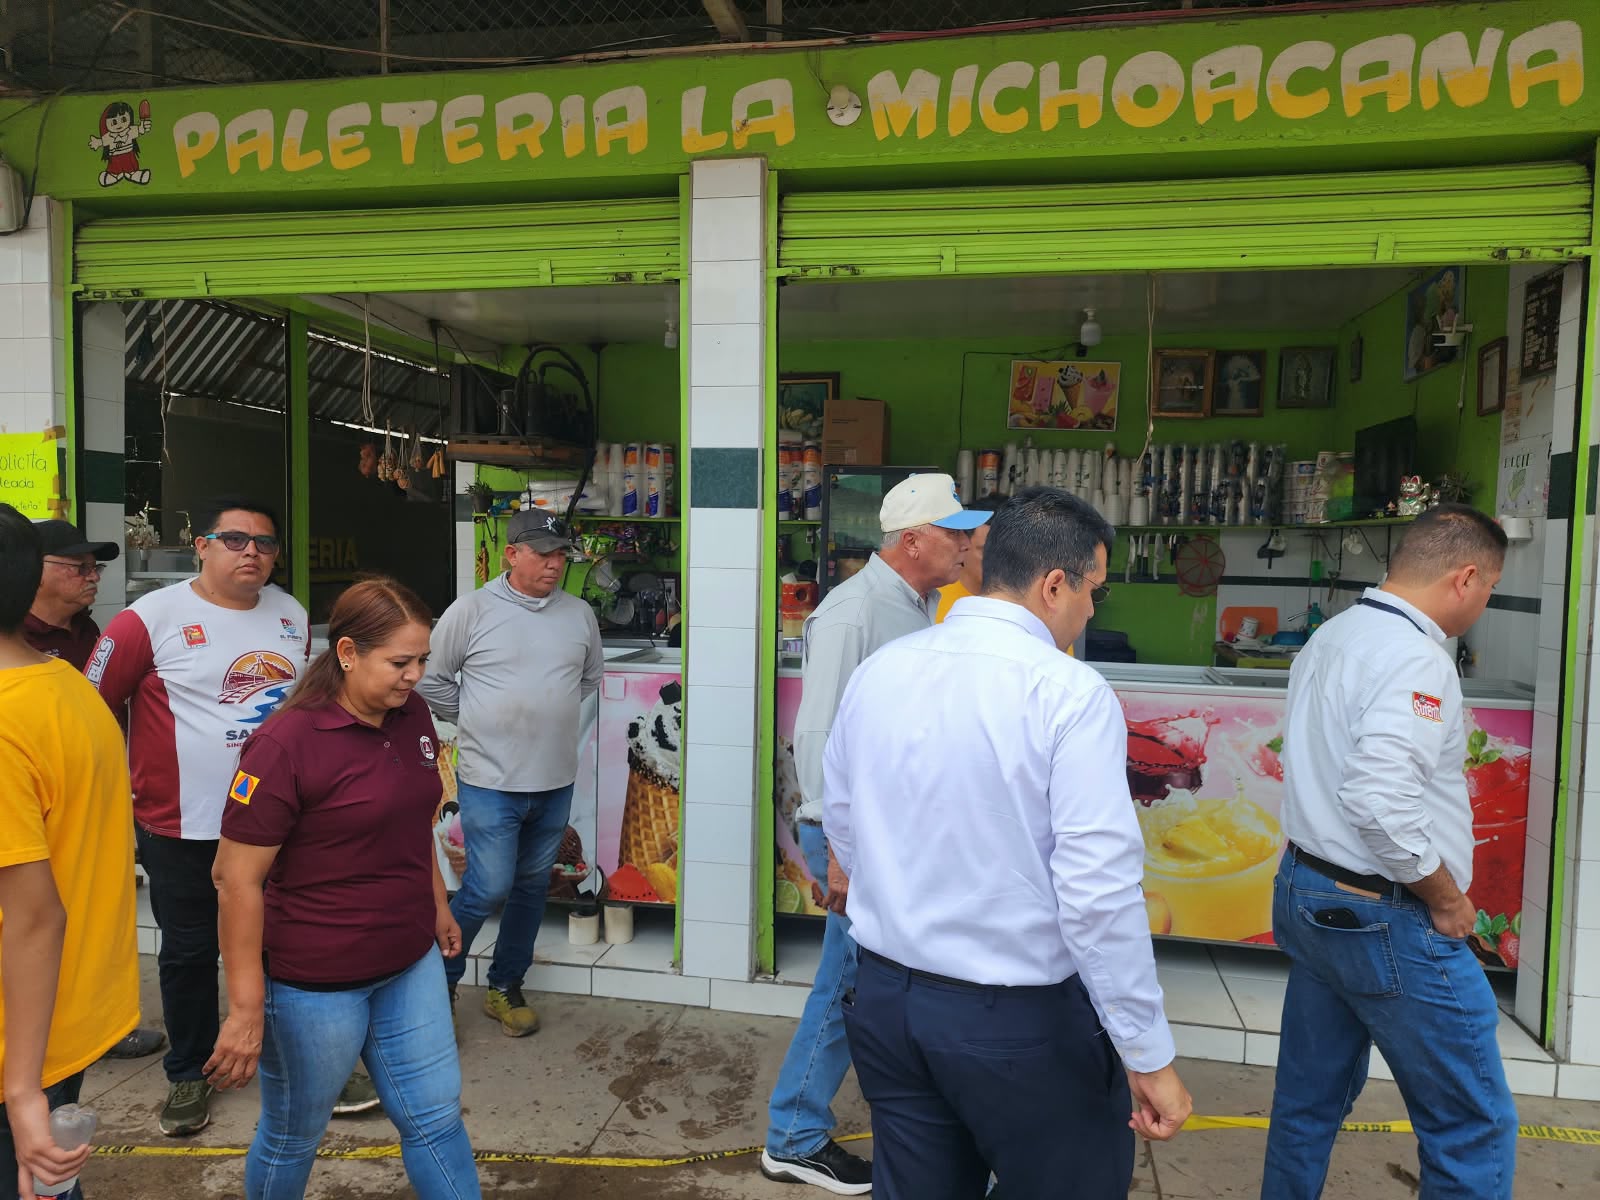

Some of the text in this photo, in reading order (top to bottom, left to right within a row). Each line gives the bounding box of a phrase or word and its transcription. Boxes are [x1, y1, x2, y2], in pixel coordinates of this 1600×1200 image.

[172, 20, 1584, 179] PALETERIA LA MICHOACANA
[0, 449, 47, 471] olicita
[86, 637, 114, 685] BLAS
[225, 728, 257, 741] SA
